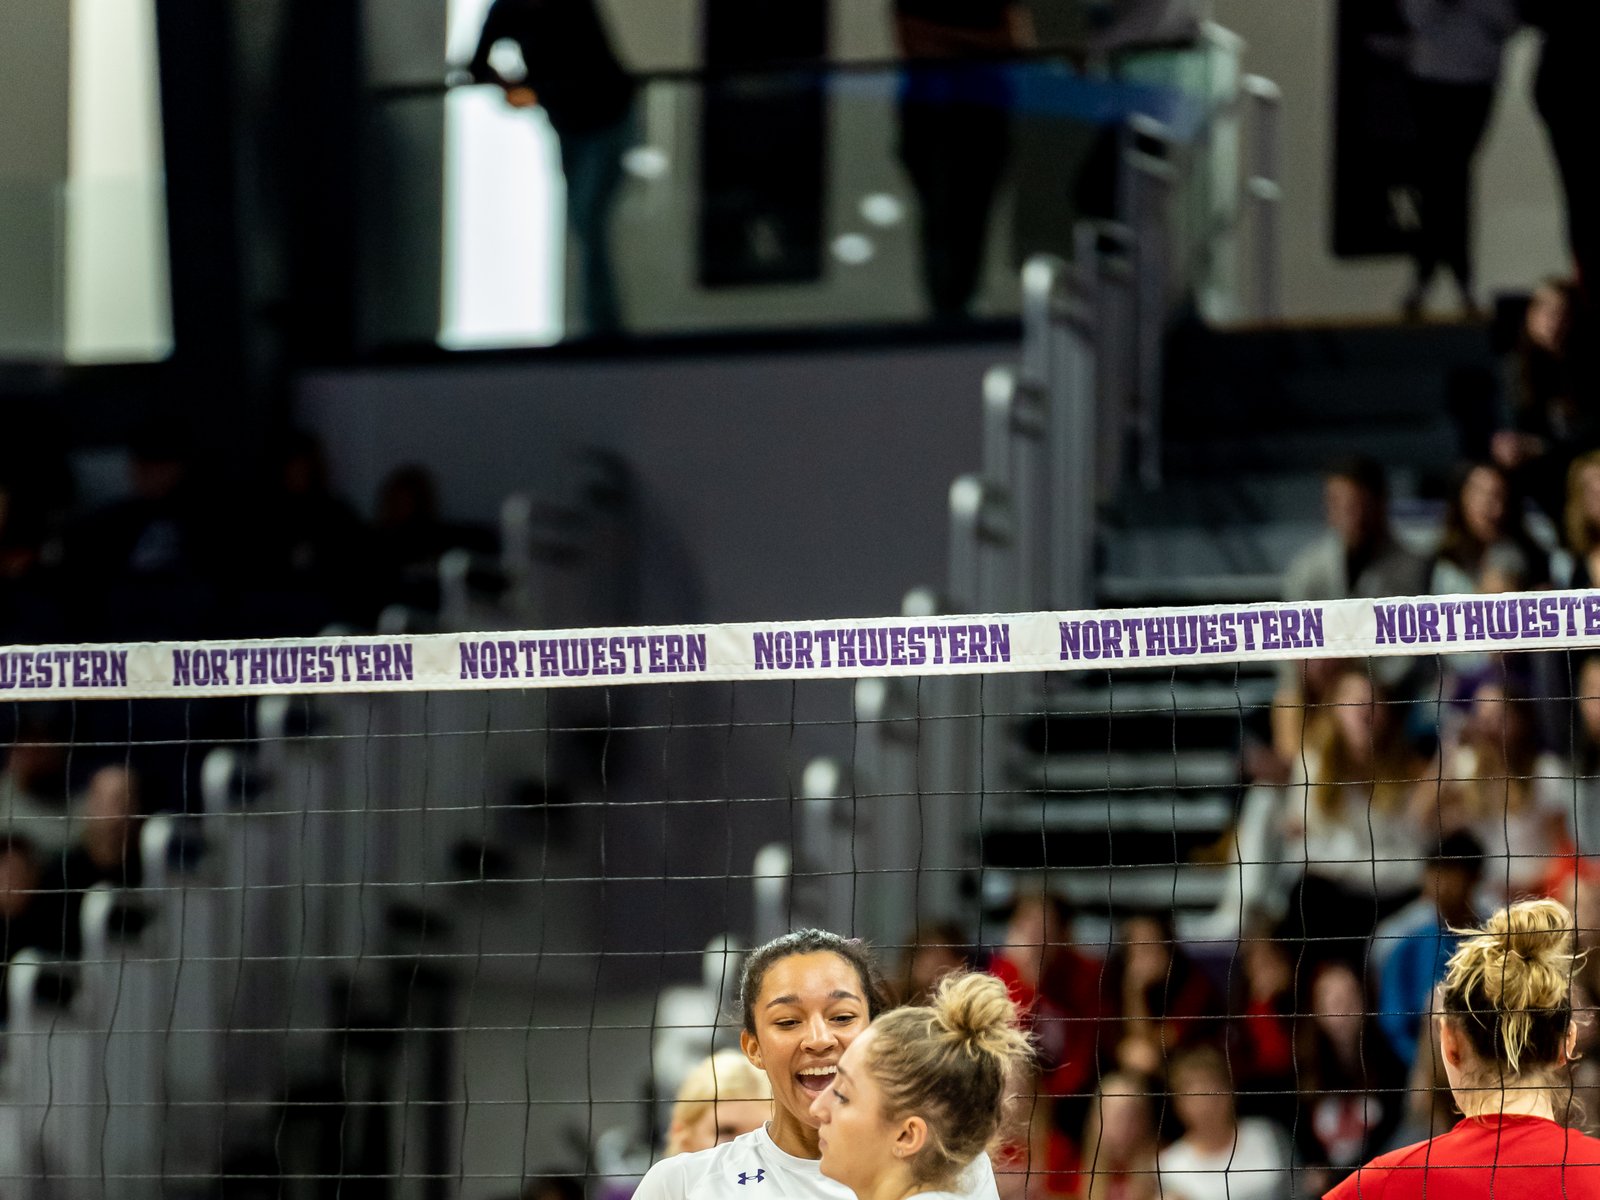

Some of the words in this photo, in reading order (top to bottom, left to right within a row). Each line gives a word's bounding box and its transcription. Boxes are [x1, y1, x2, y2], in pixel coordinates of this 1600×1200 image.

[173, 643, 414, 687] NORTHWESTERN
[459, 633, 706, 679] NORTHWESTERN
[753, 623, 1011, 669] NORTHWESTERN
[1059, 608, 1324, 660] NORTHWESTERN
[1375, 596, 1600, 644] NORTHWESTE
